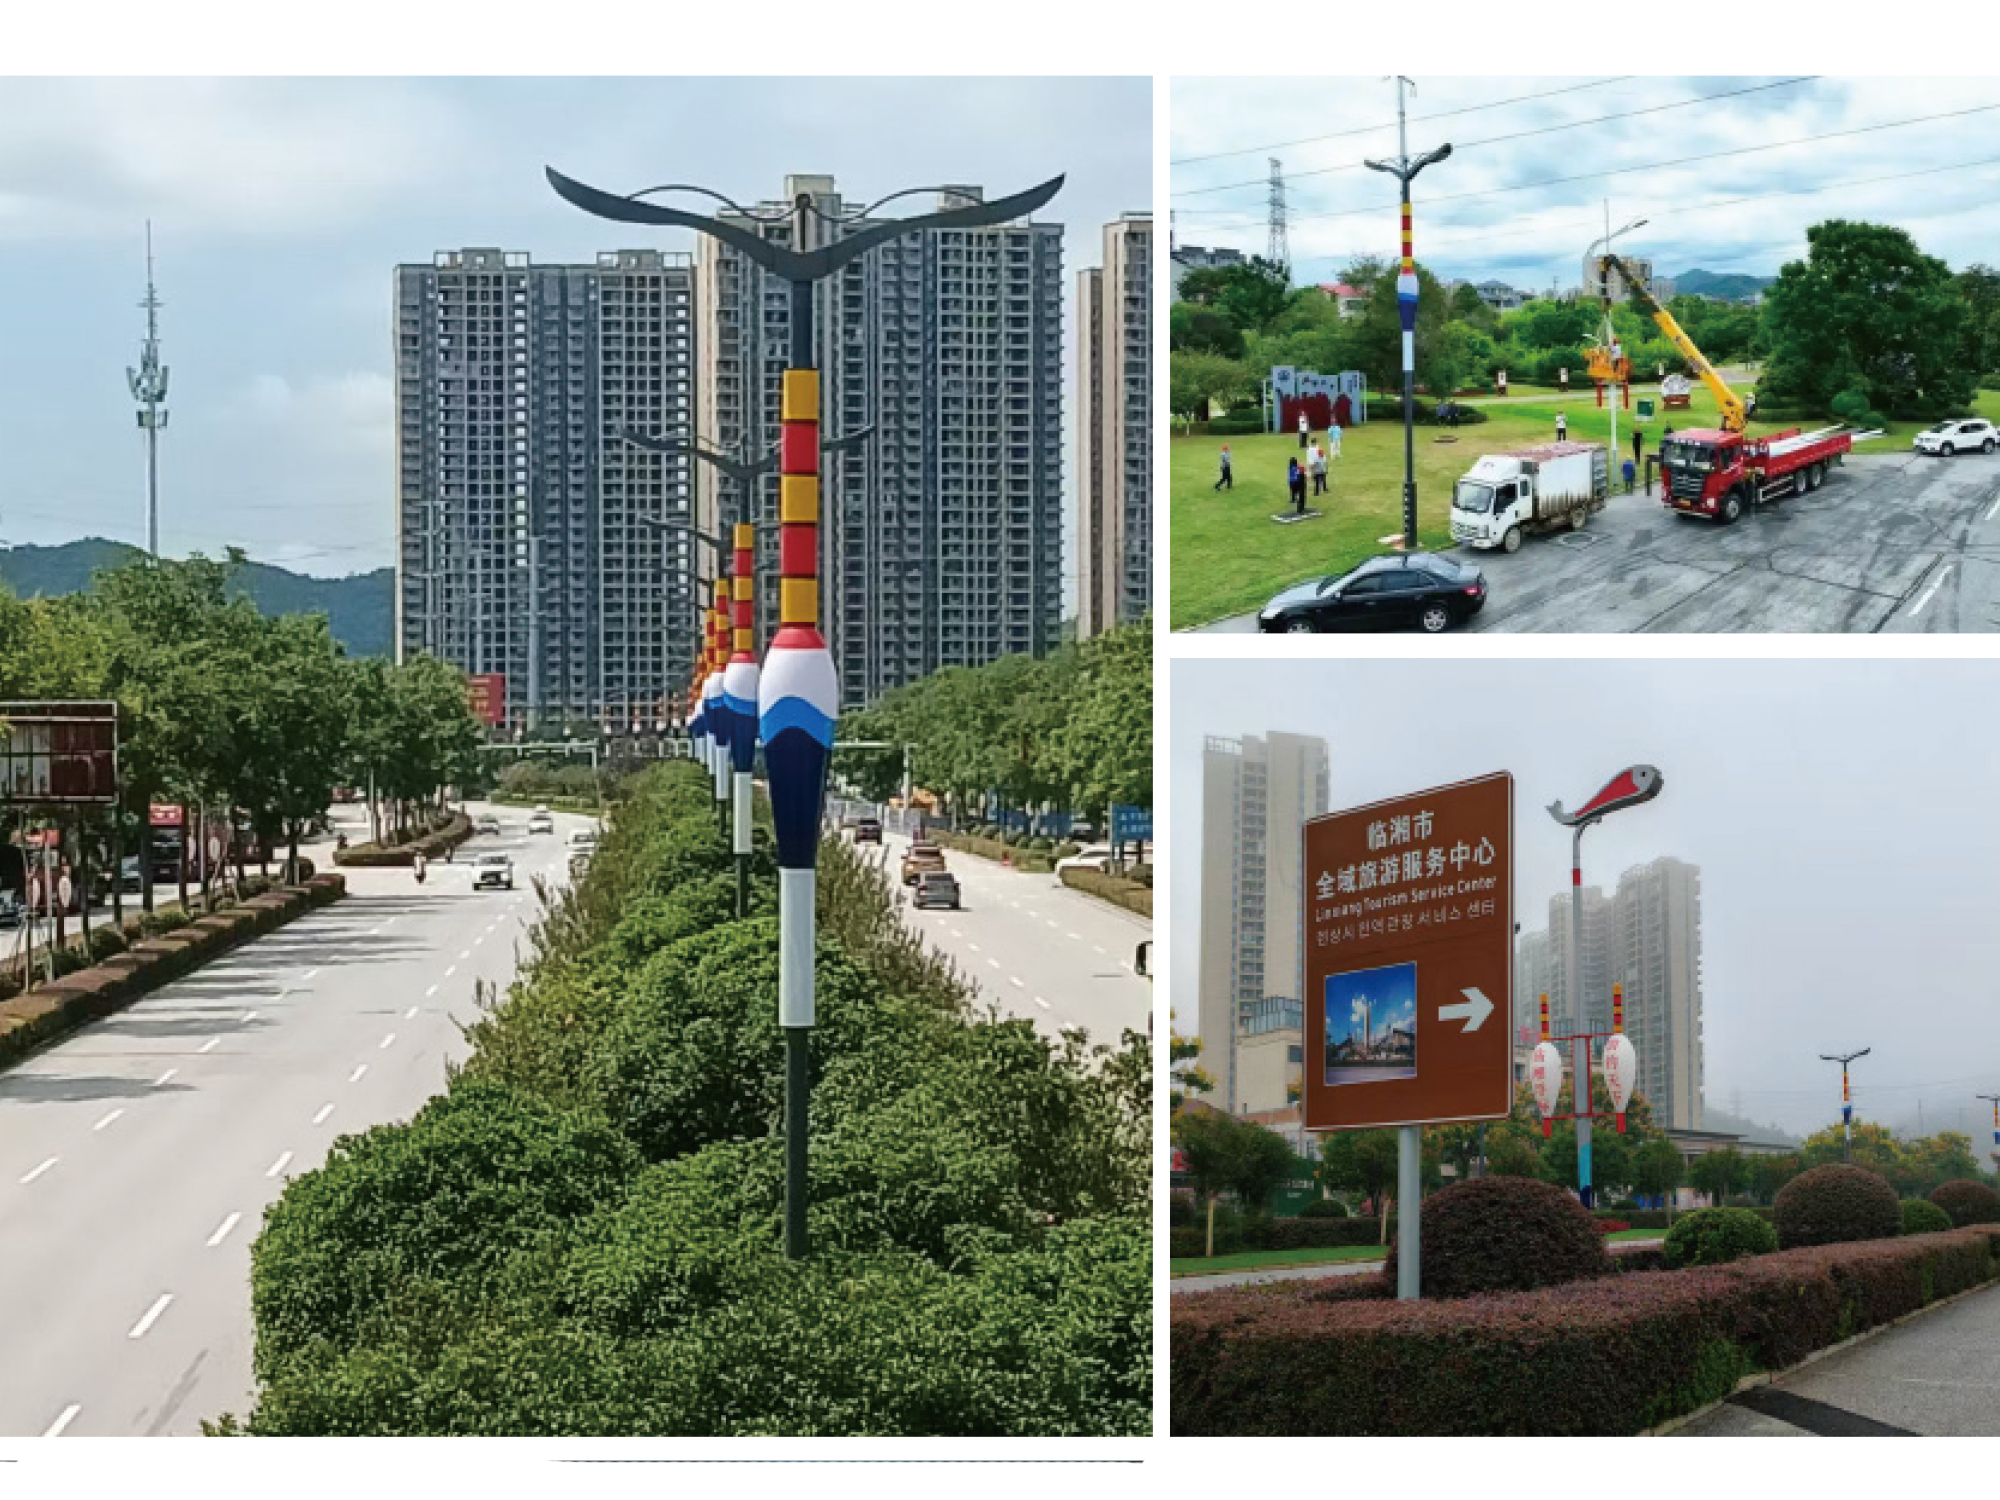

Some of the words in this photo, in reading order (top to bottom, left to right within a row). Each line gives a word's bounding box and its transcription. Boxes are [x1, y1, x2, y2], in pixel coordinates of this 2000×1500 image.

[1368, 810, 1434, 851] 临湘市
[1316, 837, 1496, 900] 全域旅游服务中心
[1316, 902, 1362, 923] Linxiang
[1364, 893, 1408, 910] Tourism
[1411, 883, 1454, 903] Service
[1457, 876, 1496, 894] Center
[1417, 904, 1461, 925] 서비스
[1467, 897, 1495, 918] 센터
